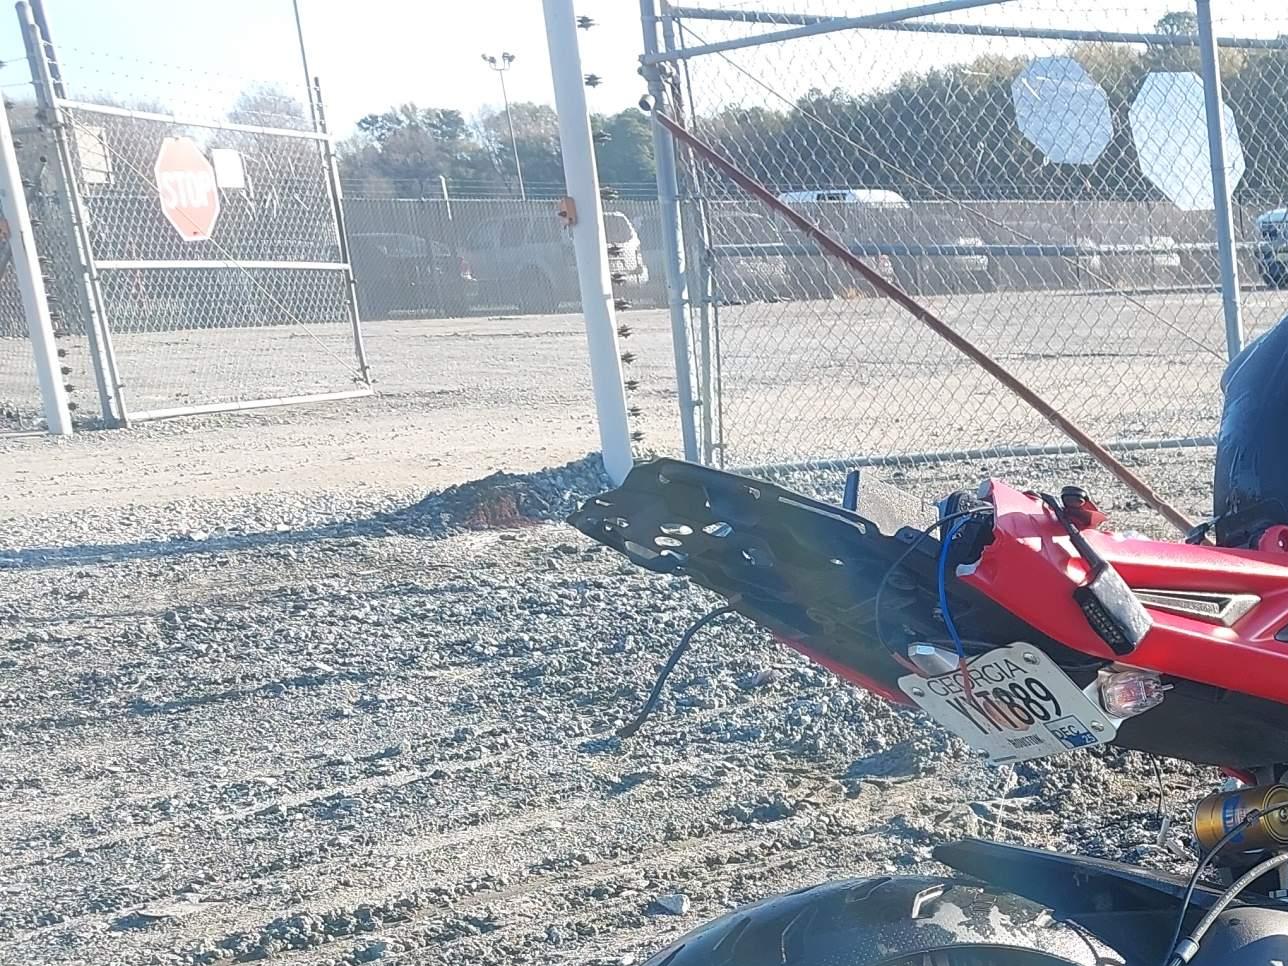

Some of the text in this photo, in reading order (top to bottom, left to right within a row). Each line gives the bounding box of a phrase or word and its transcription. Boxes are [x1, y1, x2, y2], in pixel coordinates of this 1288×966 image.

[160, 170, 214, 209] STOP
[927, 659, 1028, 696] GEORGIA
[1052, 725, 1080, 740] DEC
[1083, 735, 1096, 743] 25
